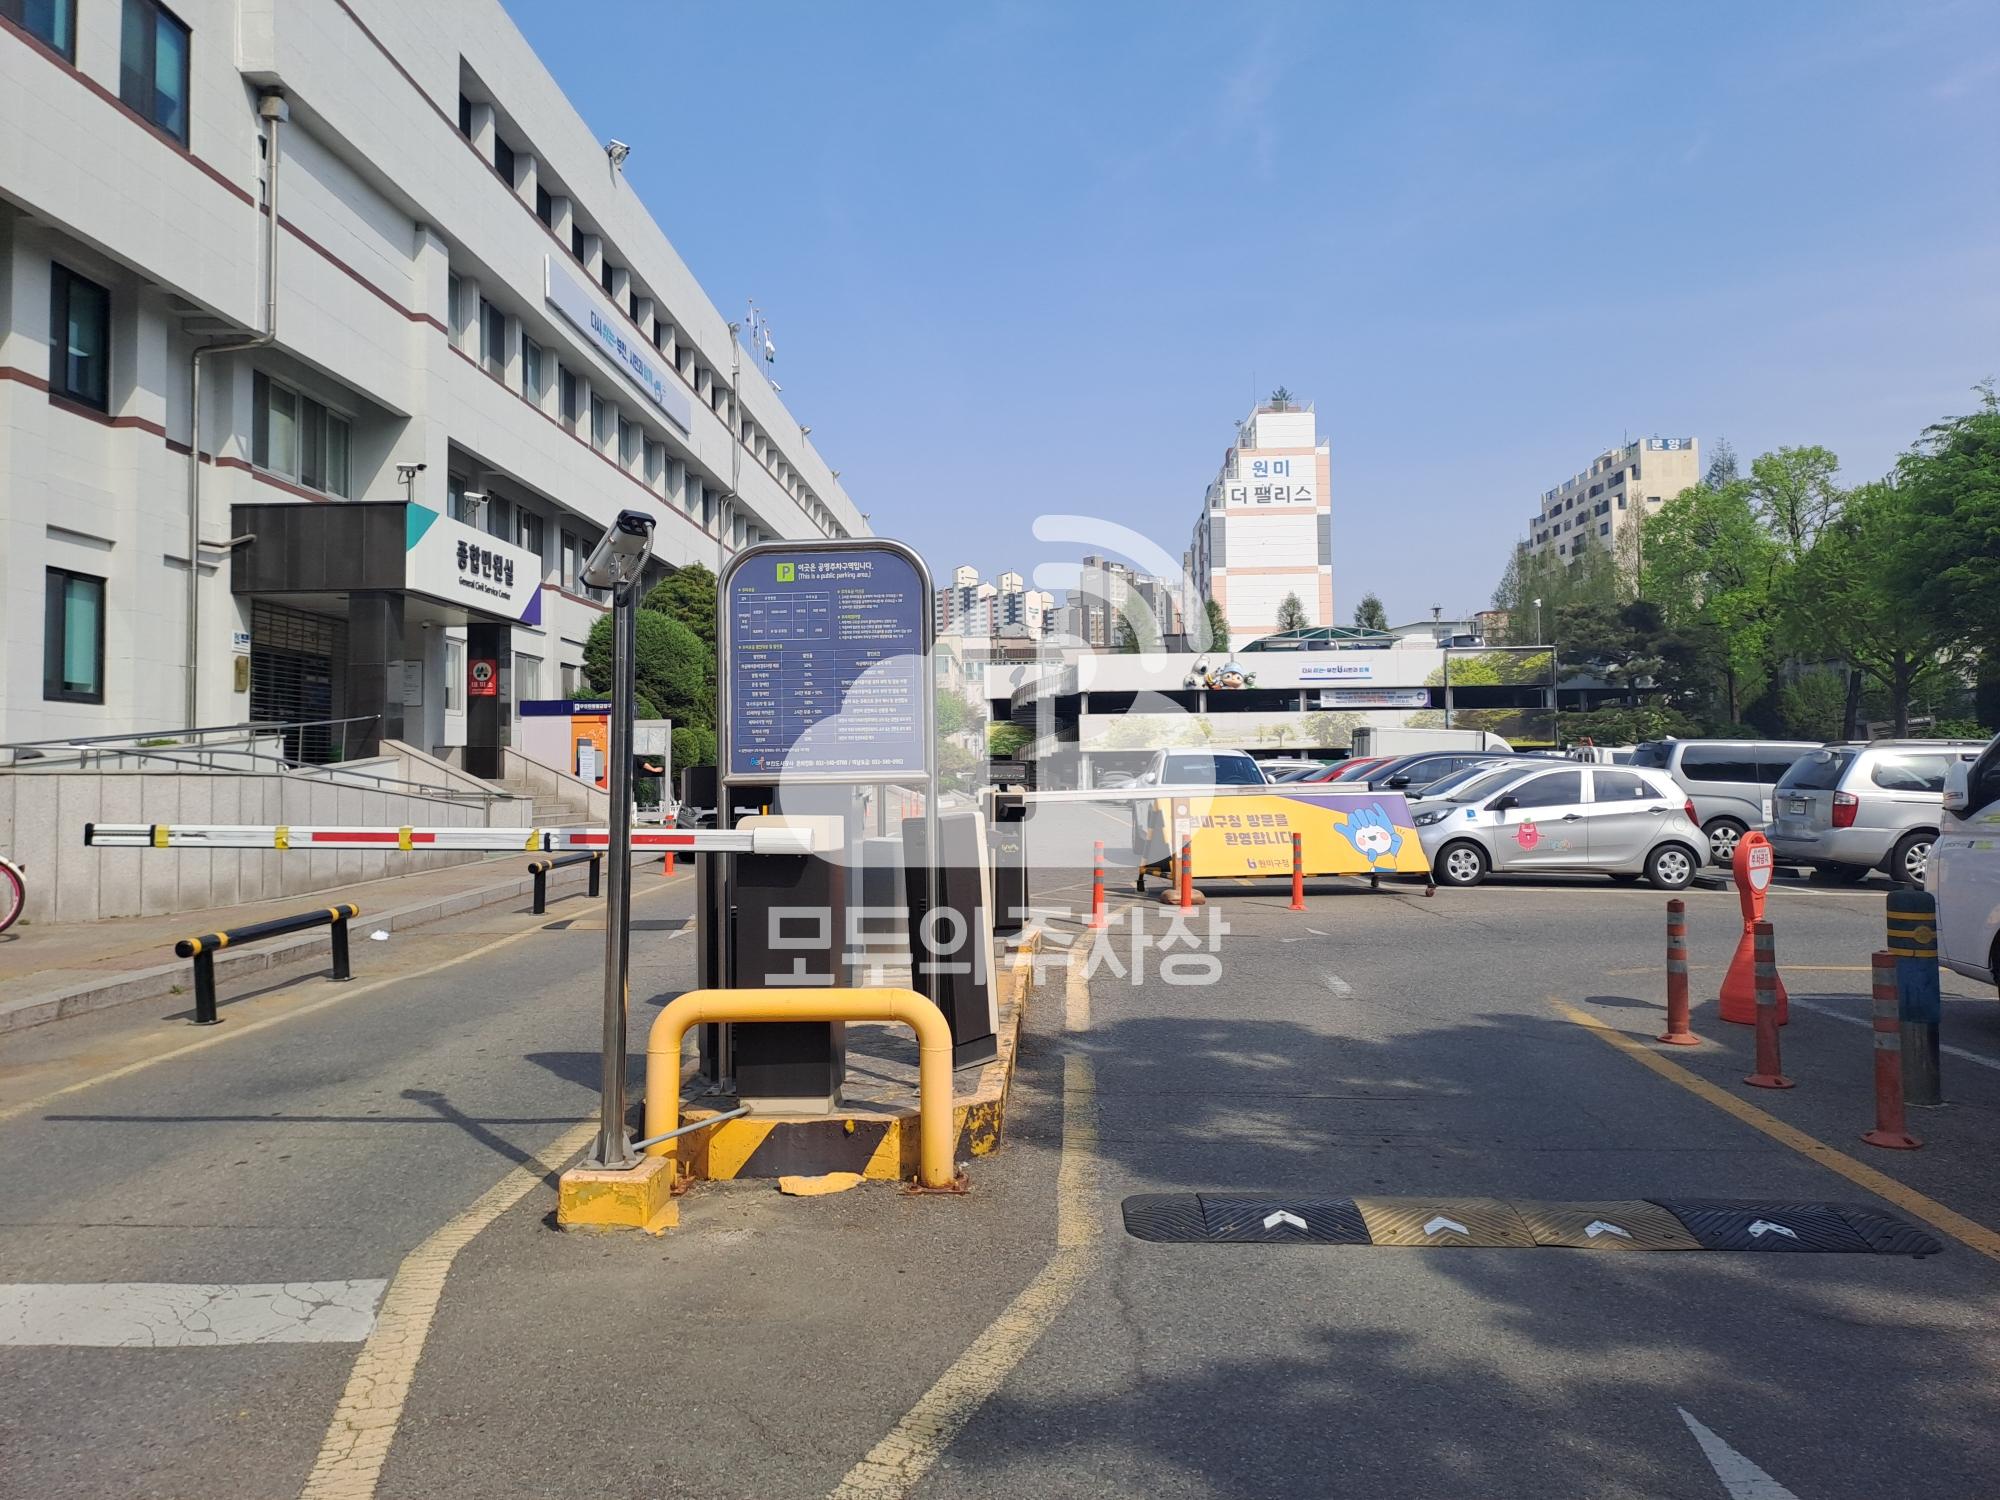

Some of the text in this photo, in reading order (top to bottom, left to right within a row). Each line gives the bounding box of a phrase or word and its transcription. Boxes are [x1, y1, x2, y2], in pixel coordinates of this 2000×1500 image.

[1252, 459, 1290, 478] 원미
[1231, 485, 1313, 504] 더 팰리스
[456, 540, 514, 587] 종합민원실
[798, 563, 816, 572] 이곳은
[798, 572, 811, 581] (This
[820, 572, 836, 580] public
[836, 571, 856, 580] parking
[459, 576, 511, 601] General Civil Service Center
[1245, 813, 1289, 828] 방문을
[1224, 831, 1293, 846] 환영합니다
[1257, 858, 1290, 869] 원미구청
